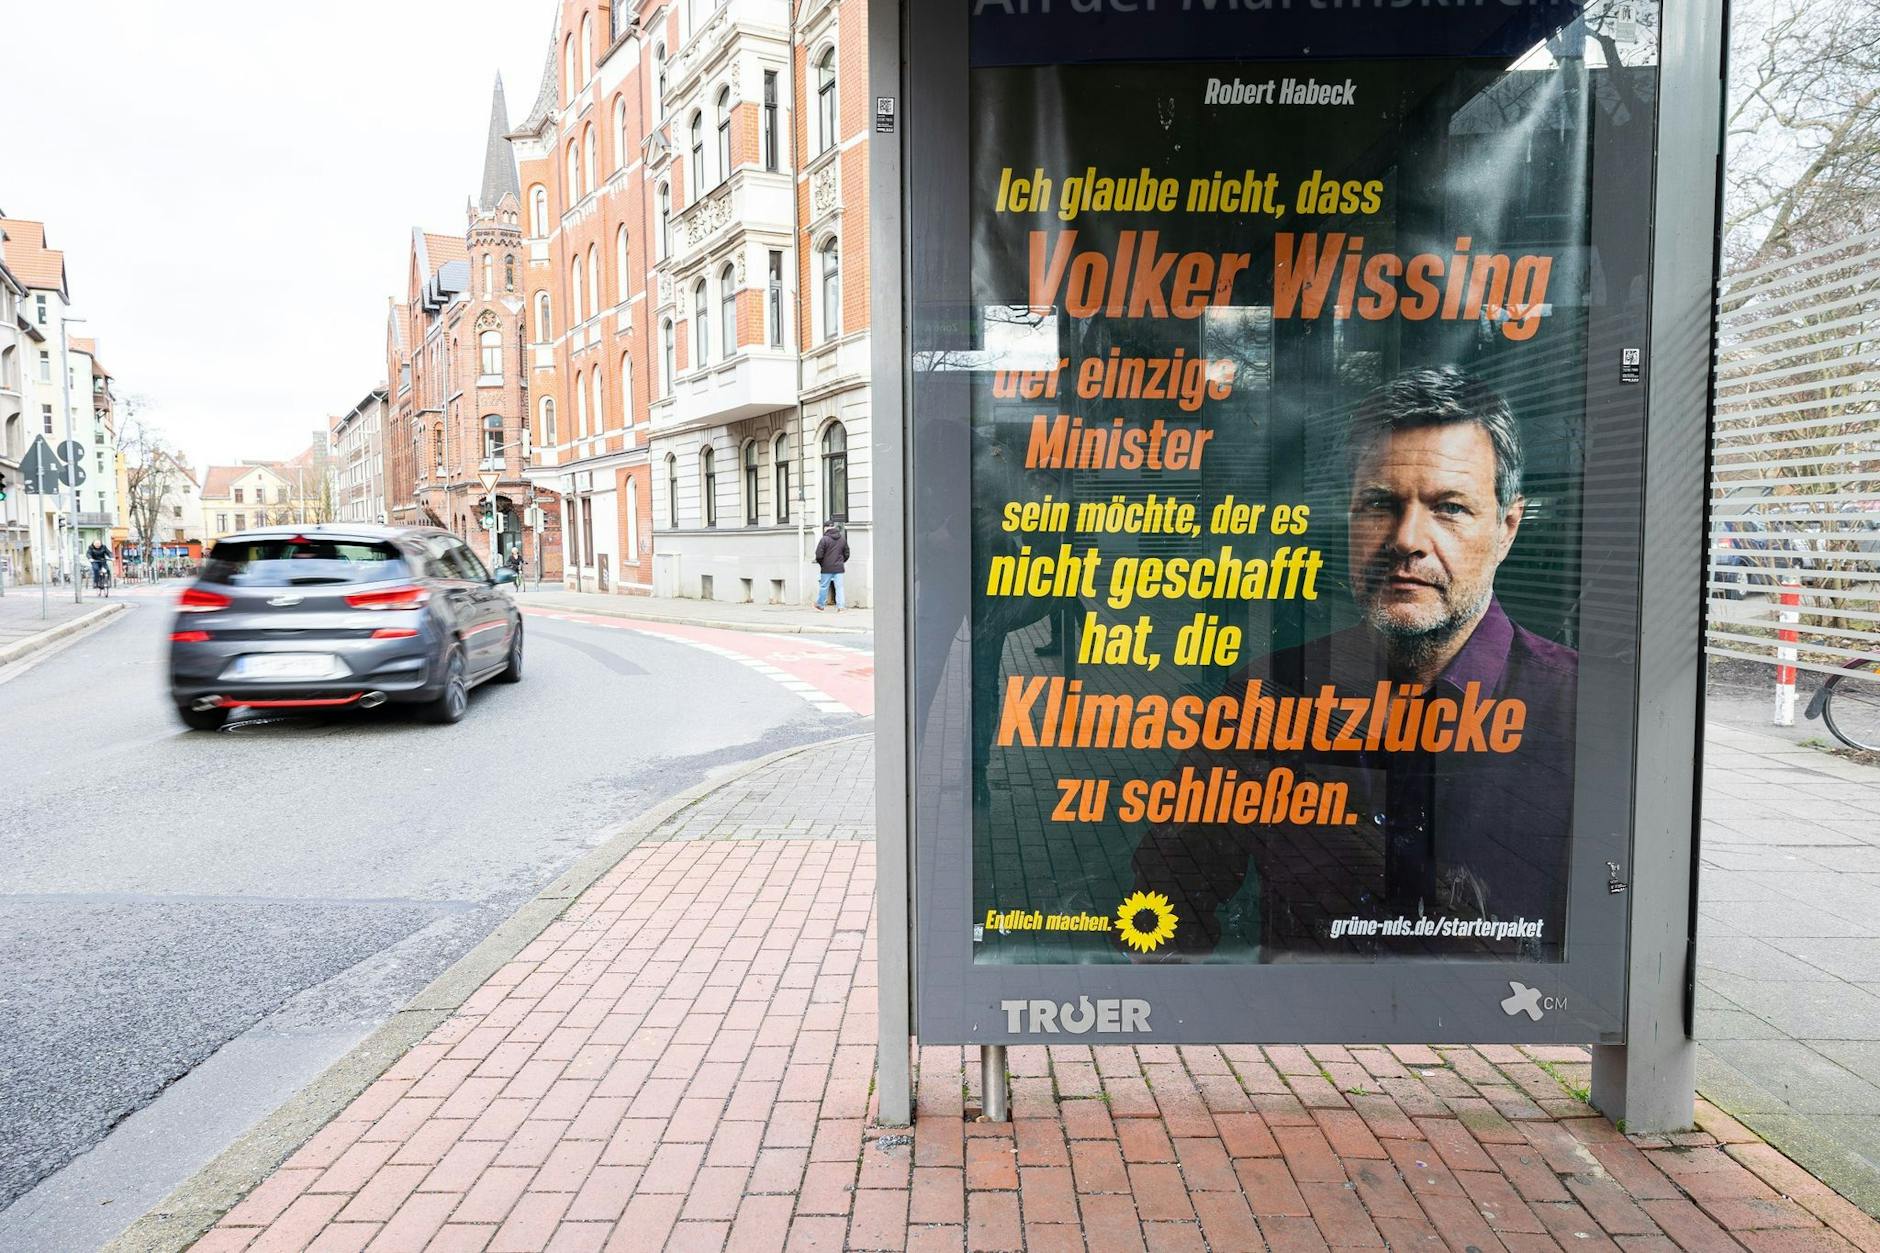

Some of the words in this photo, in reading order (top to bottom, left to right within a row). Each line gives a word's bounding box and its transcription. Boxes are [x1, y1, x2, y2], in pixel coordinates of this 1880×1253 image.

[1204, 78, 1275, 105] Robert
[1279, 78, 1357, 105] Habeck
[996, 167, 1052, 212] Ich
[1058, 167, 1178, 221] glaube
[1187, 169, 1285, 219] nicht,
[1295, 169, 1383, 214] dass
[1028, 230, 1250, 320] Volker
[1274, 232, 1552, 341] Wissing
[1076, 347, 1237, 410] einzige
[1025, 414, 1214, 471] Minister
[1002, 498, 1069, 533] sein
[1076, 494, 1201, 538] möchte,
[1211, 495, 1264, 535] der
[1271, 503, 1311, 536] es
[987, 545, 1102, 597] nicht
[1109, 545, 1324, 609] geschafft
[1077, 612, 1160, 672] hat,
[1173, 613, 1242, 665] die
[996, 675, 1528, 753] Klimaschutzlücke
[1051, 778, 1110, 822] zu
[1118, 766, 1358, 826] schließen.
[985, 910, 1043, 930] Endlich
[1045, 911, 1112, 932] machen.
[1330, 916, 1544, 941] grüne-nds.de/starterpaket
[1543, 997, 1568, 1010] CM
